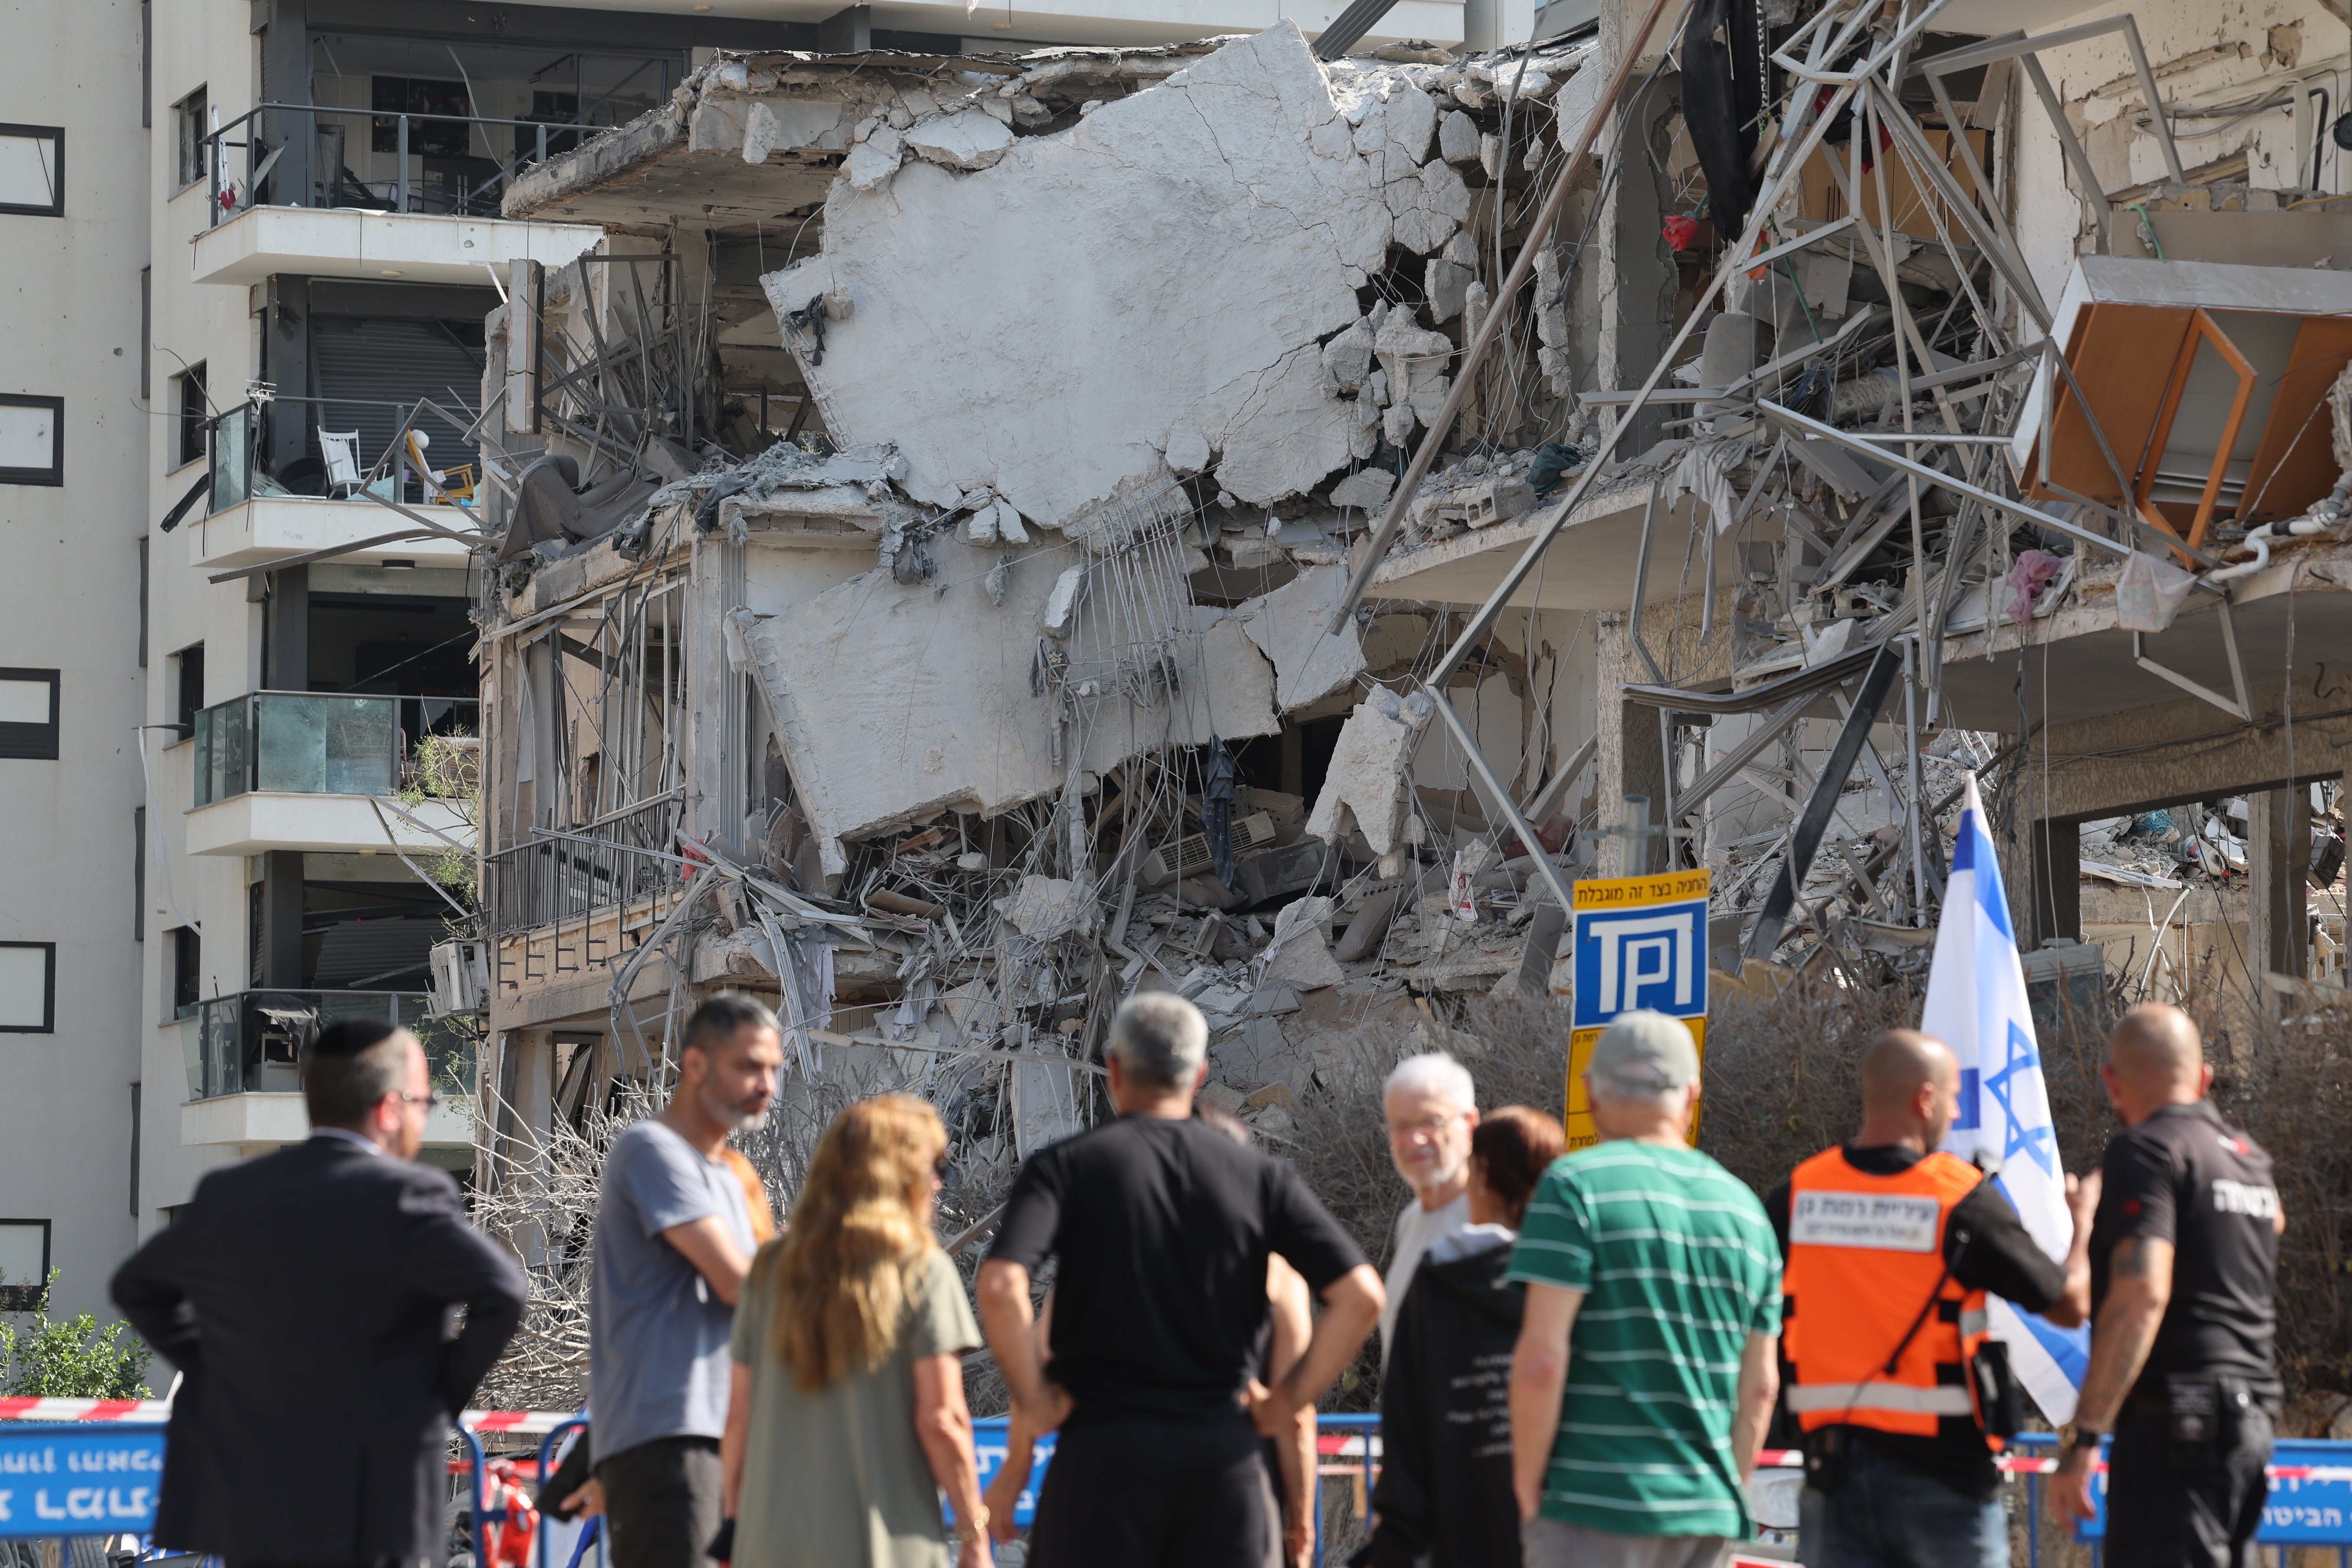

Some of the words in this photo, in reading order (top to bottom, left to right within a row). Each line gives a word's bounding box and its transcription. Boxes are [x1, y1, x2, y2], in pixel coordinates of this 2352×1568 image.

[1629, 886, 1644, 899] זה
[1650, 883, 1672, 897] בצד
[1677, 877, 1708, 894] החניה
[1578, 887, 1624, 903] מוגבלת
[34, 1486, 152, 1521] רמת
